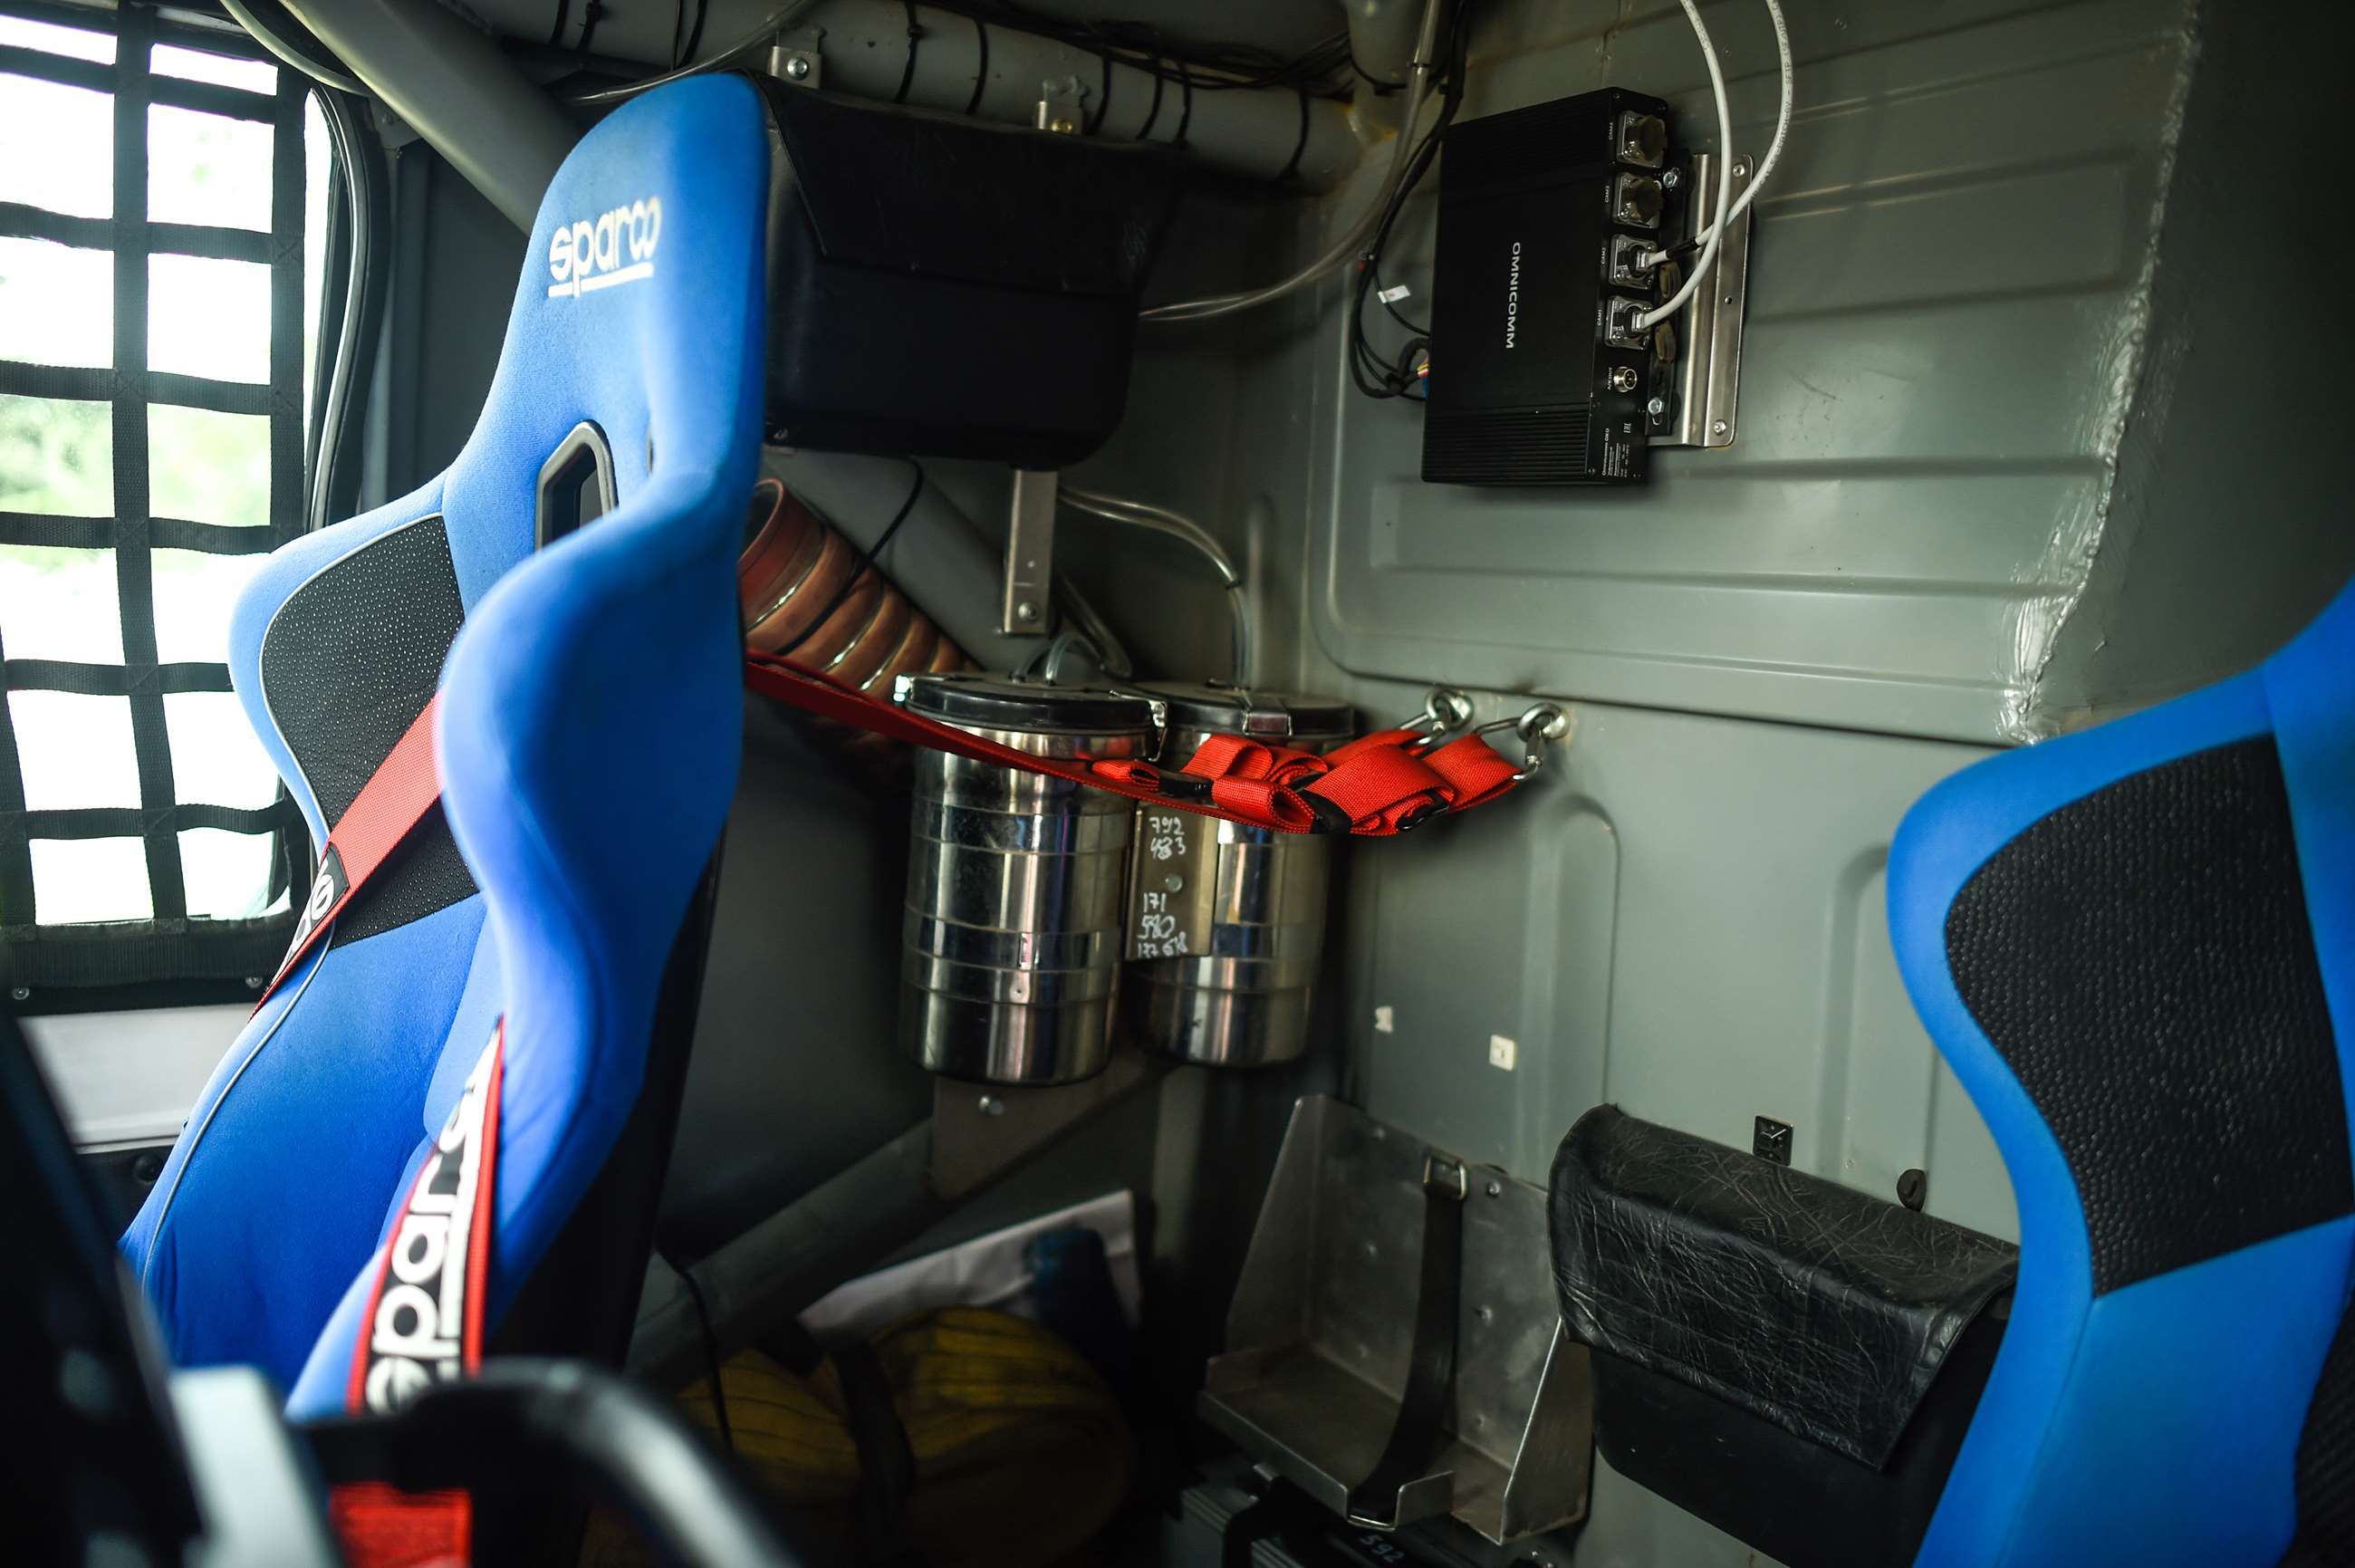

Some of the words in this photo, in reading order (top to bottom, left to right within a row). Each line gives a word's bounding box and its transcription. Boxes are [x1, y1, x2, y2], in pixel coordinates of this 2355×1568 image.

[549, 196, 662, 297] sparco
[1505, 241, 1521, 349] OMNICOMM
[1149, 816, 1185, 835] 792
[1143, 892, 1167, 913] 171
